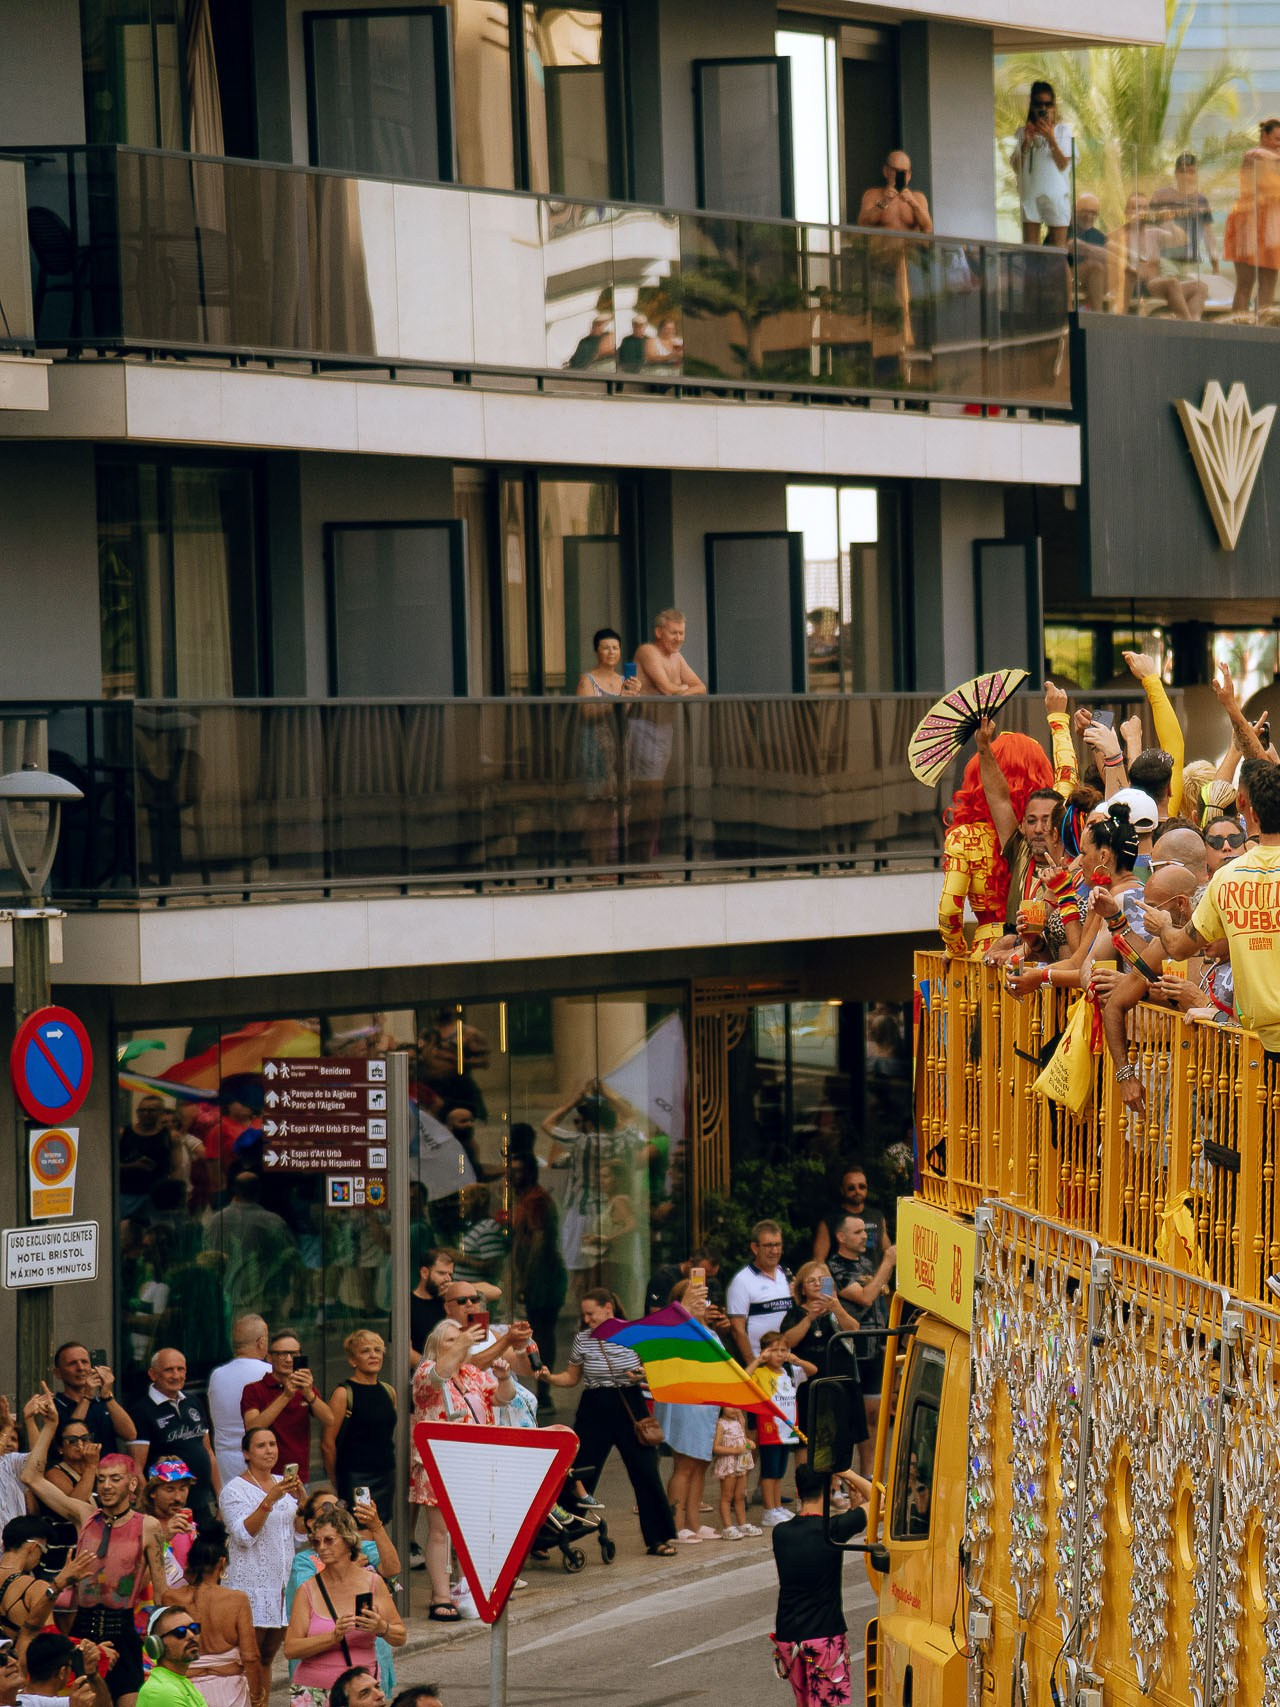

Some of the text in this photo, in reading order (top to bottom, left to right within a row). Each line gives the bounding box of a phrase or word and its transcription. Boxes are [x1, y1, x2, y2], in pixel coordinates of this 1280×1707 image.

[320, 1066, 351, 1075] Benidorm
[291, 1089, 357, 1100] Parque de la Aigüera
[291, 1101, 306, 1109] Parc
[307, 1101, 316, 1109] de
[290, 1124, 366, 1134] Espai d'Art Urbà El Pont
[291, 1149, 342, 1159] Espai d'Art Urbà
[311, 1159, 320, 1168] de
[328, 1159, 361, 1168] Hispanitat
[10, 1229, 93, 1249] USO EXCLUSIVO CLIENTES
[17, 1247, 85, 1264] HOTEL BRISTOL
[10, 1262, 92, 1280] MÁXIMO 15 MINUTOS
